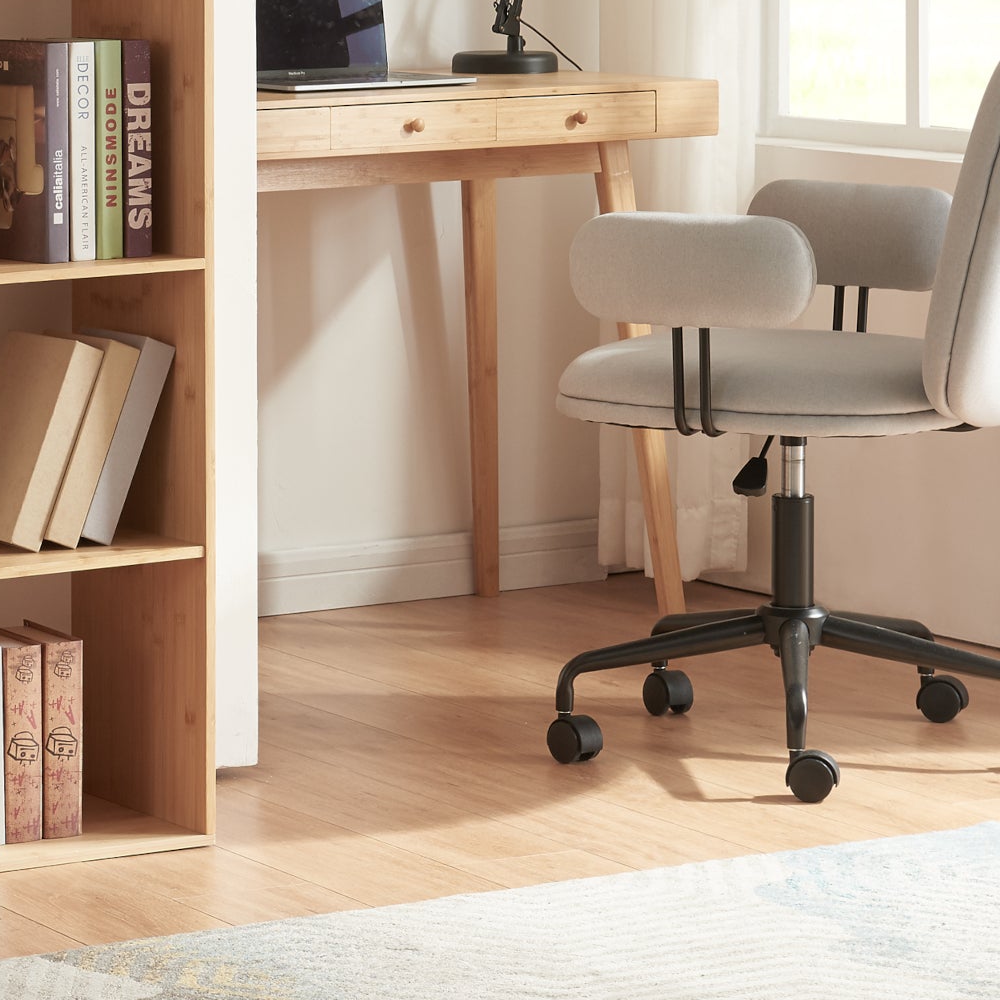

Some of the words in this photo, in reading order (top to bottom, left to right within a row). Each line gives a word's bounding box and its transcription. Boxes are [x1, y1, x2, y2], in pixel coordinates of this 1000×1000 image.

[77, 63, 90, 120] DECOR
[53, 149, 63, 210] caliaitalia
[81, 146, 89, 219] ALL-AMERICAN
[105, 88, 118, 208] NINSMODE
[127, 83, 153, 229] DREAMS
